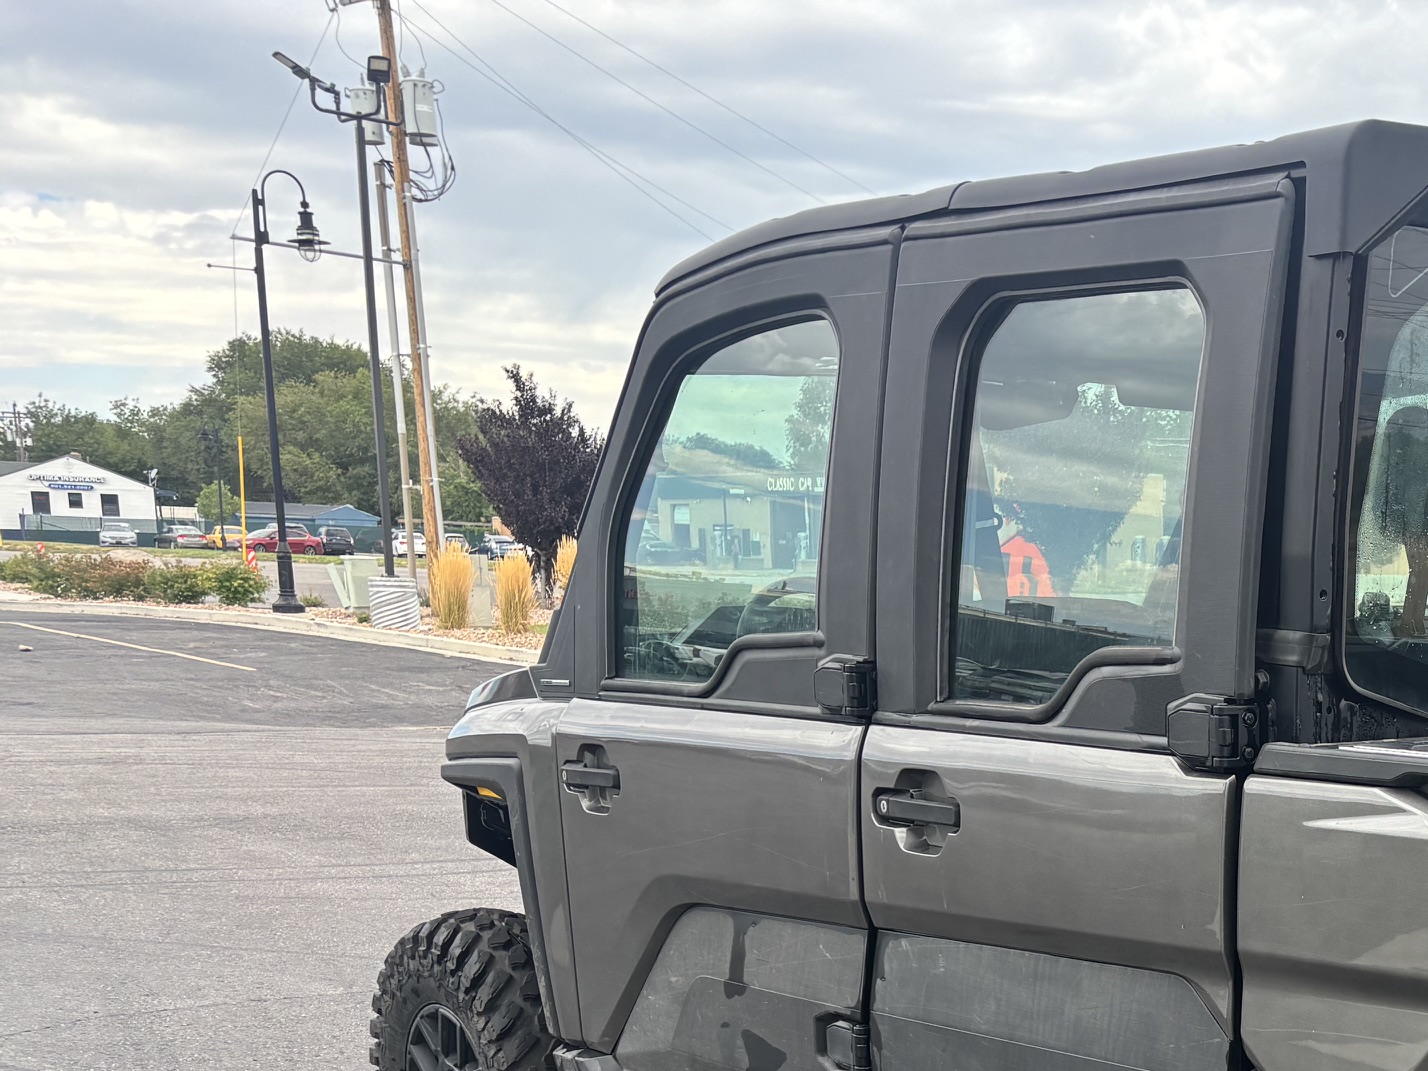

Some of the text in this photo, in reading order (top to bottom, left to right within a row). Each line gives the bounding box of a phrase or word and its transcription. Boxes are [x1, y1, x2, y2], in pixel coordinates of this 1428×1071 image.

[28, 474, 106, 483] OPTIMA INSURANCE
[767, 477, 795, 491] CLASSIC
